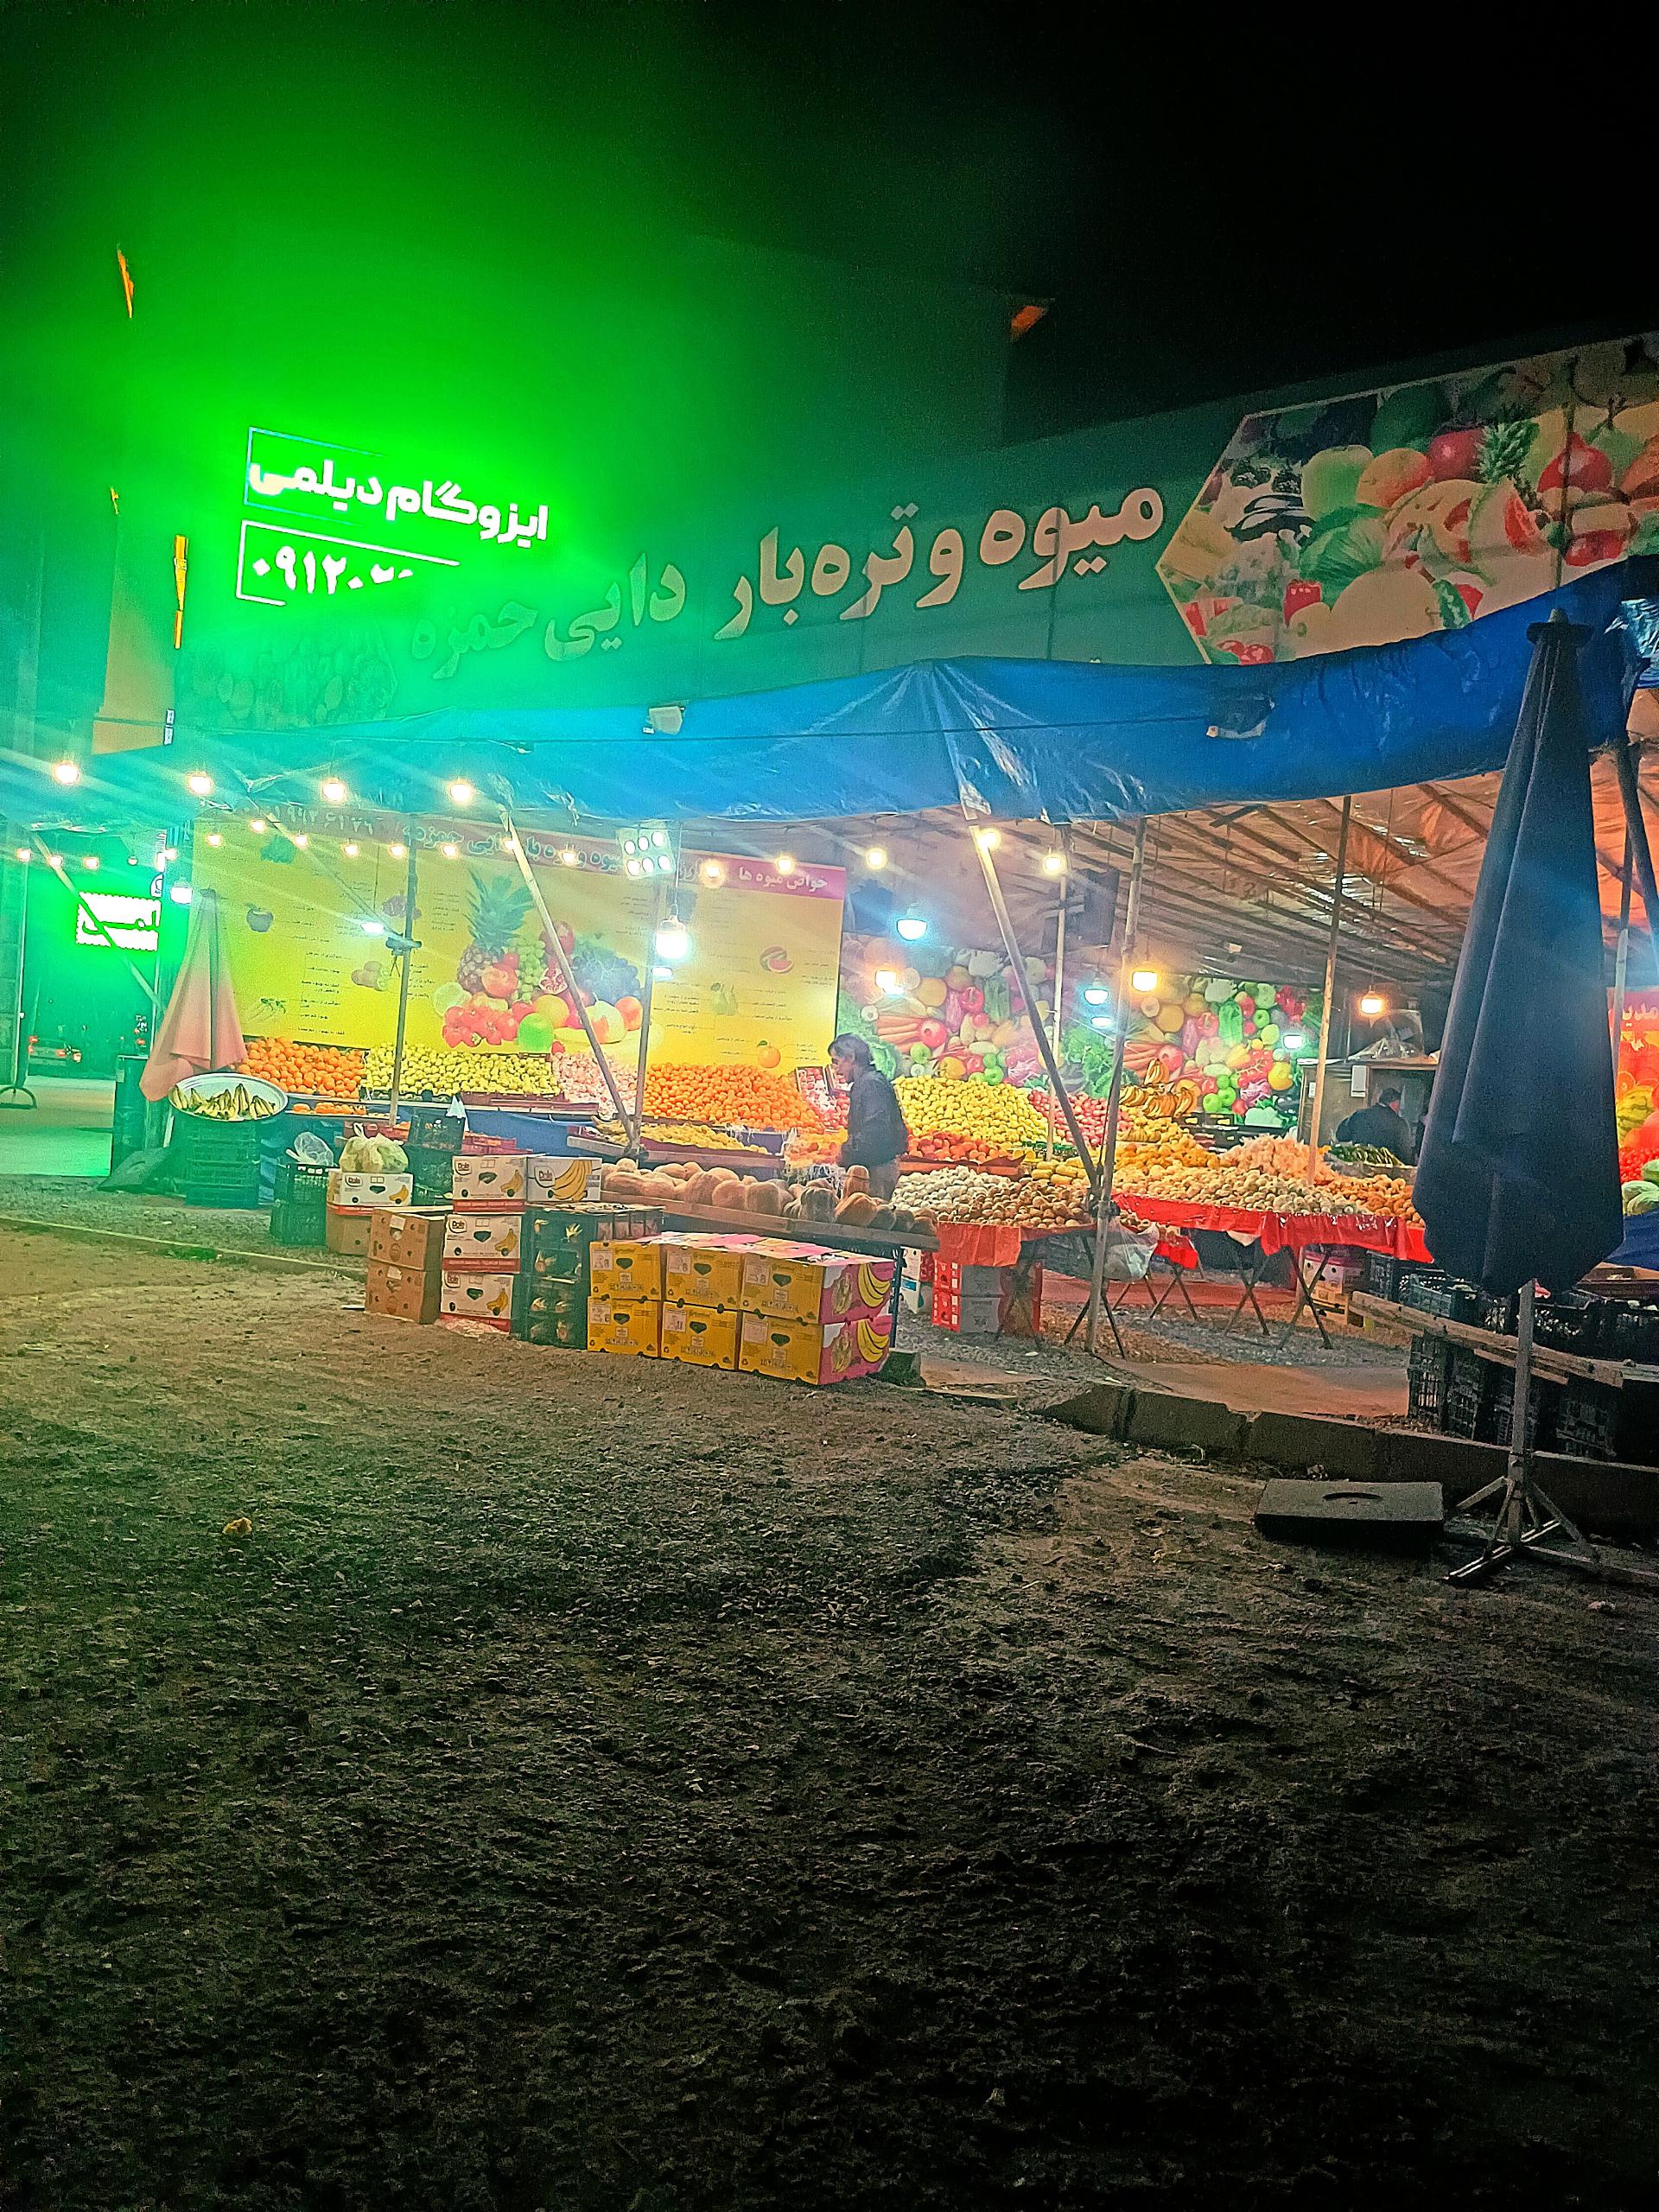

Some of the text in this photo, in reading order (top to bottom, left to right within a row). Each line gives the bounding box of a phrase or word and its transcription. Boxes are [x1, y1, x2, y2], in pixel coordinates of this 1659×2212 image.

[248, 459, 549, 549] ایزوگام دیلمی
[979, 486, 1165, 591] میوه
[411, 601, 538, 680] حمزه
[544, 553, 686, 663] دایی
[738, 866, 828, 893] خواص میوه ها
[458, 1161, 470, 1170] Dole
[538, 1171, 553, 1180] Dole
